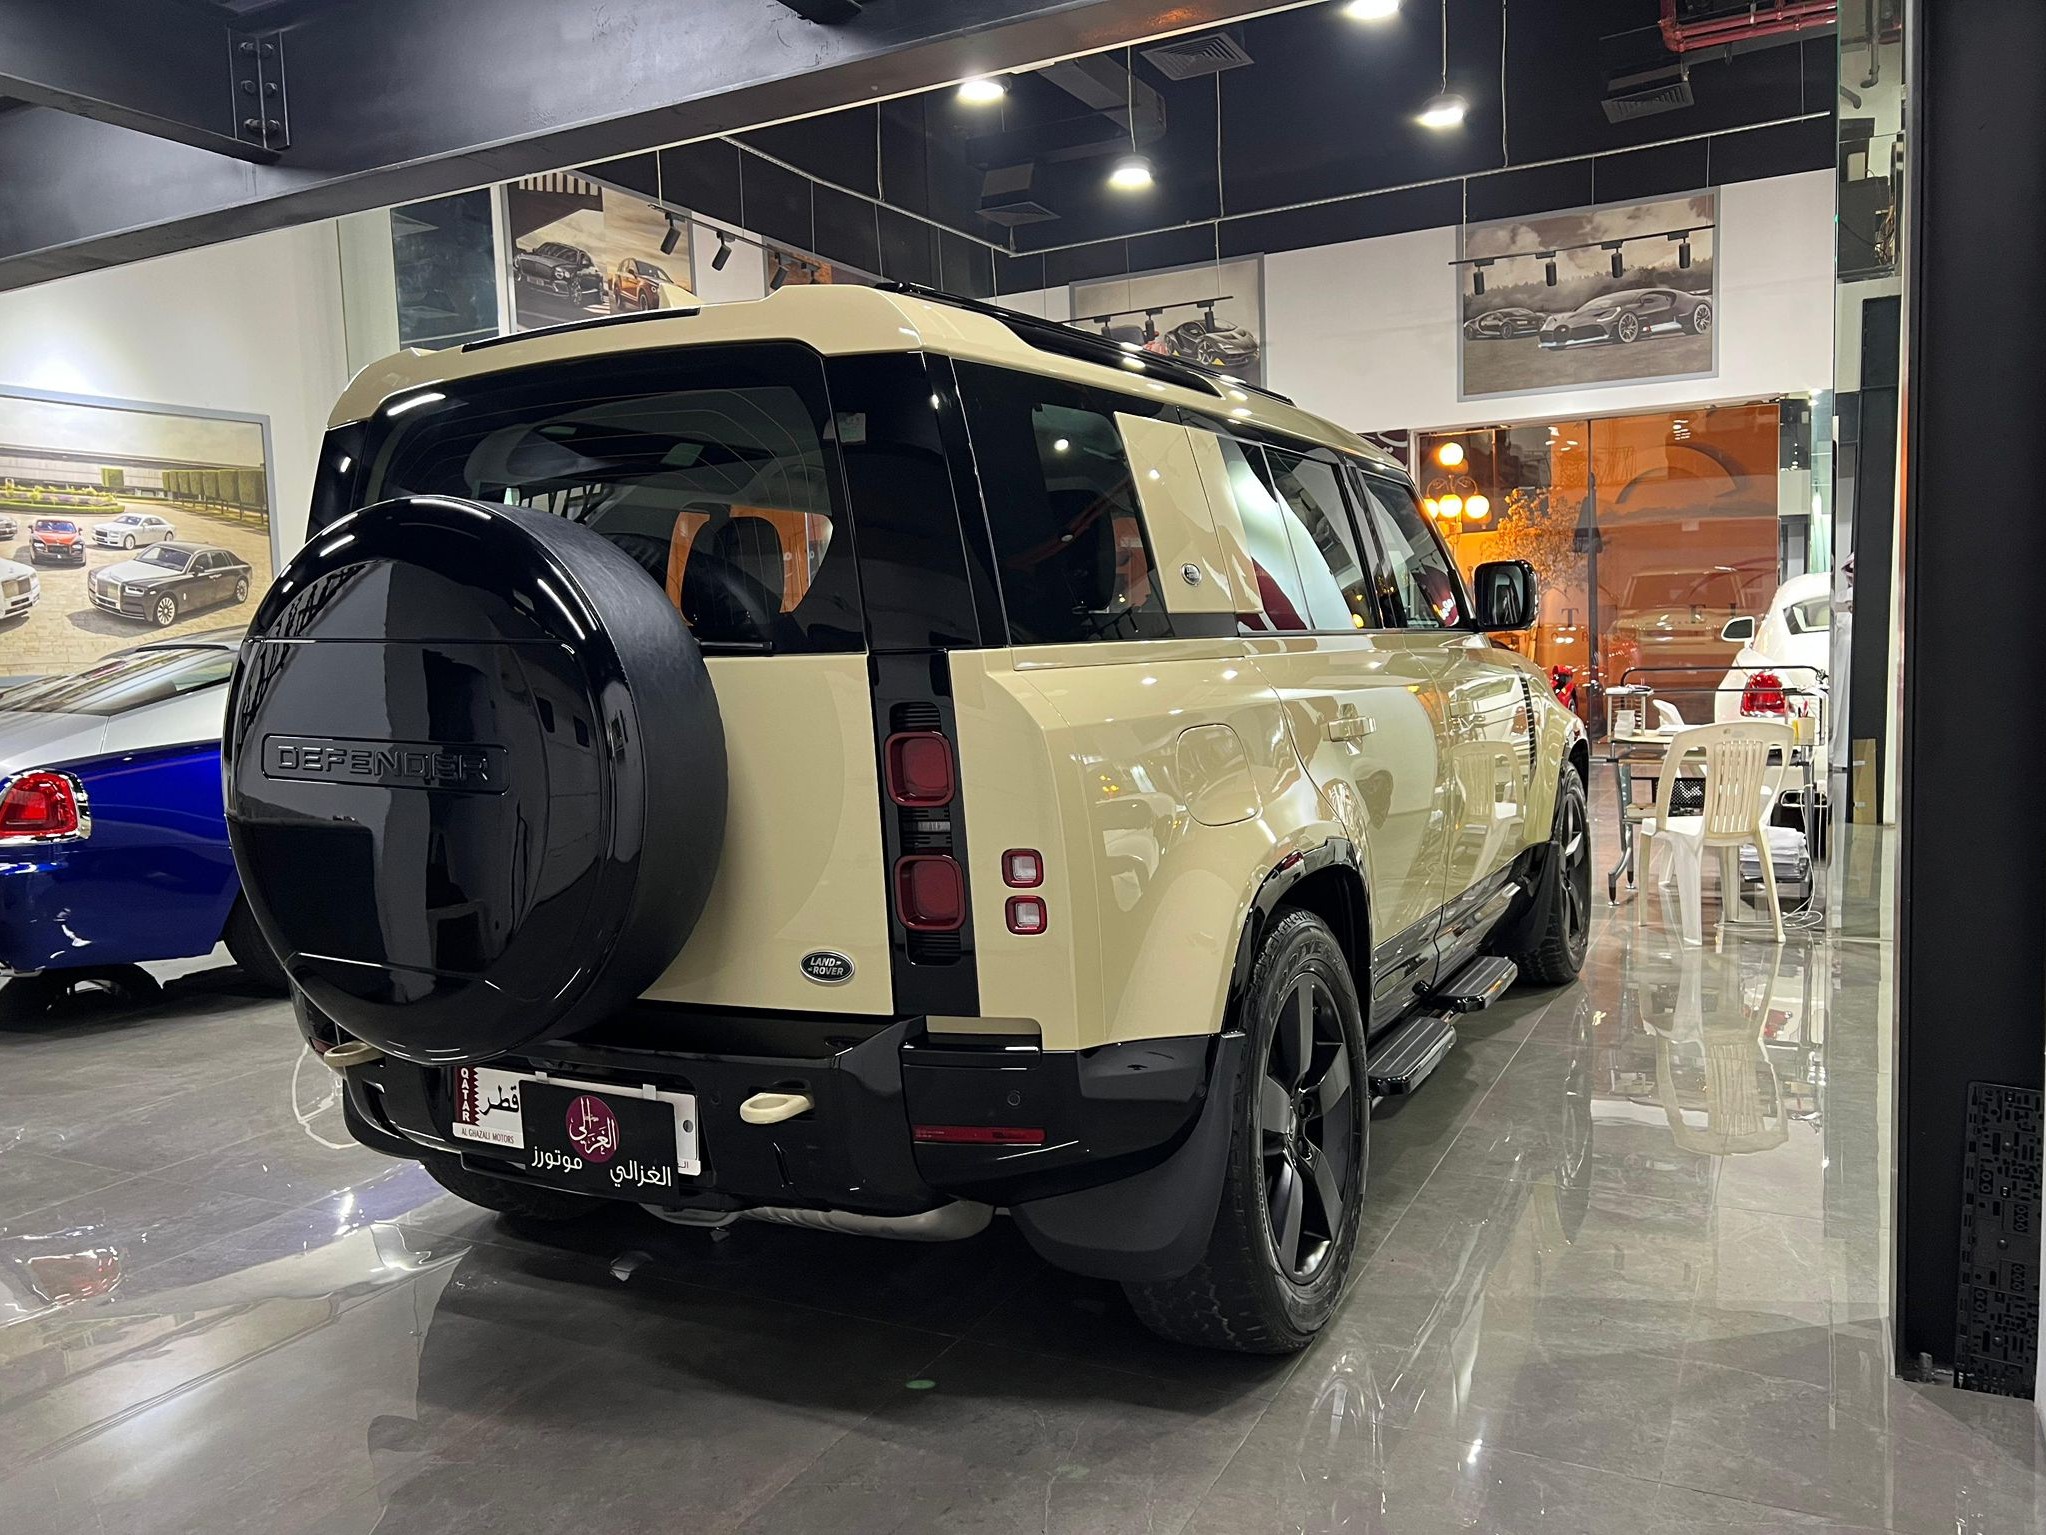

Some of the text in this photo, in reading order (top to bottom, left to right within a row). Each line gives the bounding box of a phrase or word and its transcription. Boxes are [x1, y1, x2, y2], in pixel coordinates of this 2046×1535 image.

[277, 745, 488, 781] DEFENDER
[810, 957, 836, 967] LAND
[812, 966, 844, 976] ROVER
[460, 1067, 471, 1122] QATAR
[479, 1085, 520, 1116] قطر
[461, 1127, 515, 1145] AL GHAZALI MOTORS
[531, 1146, 673, 1188] الغزالي موتورز
